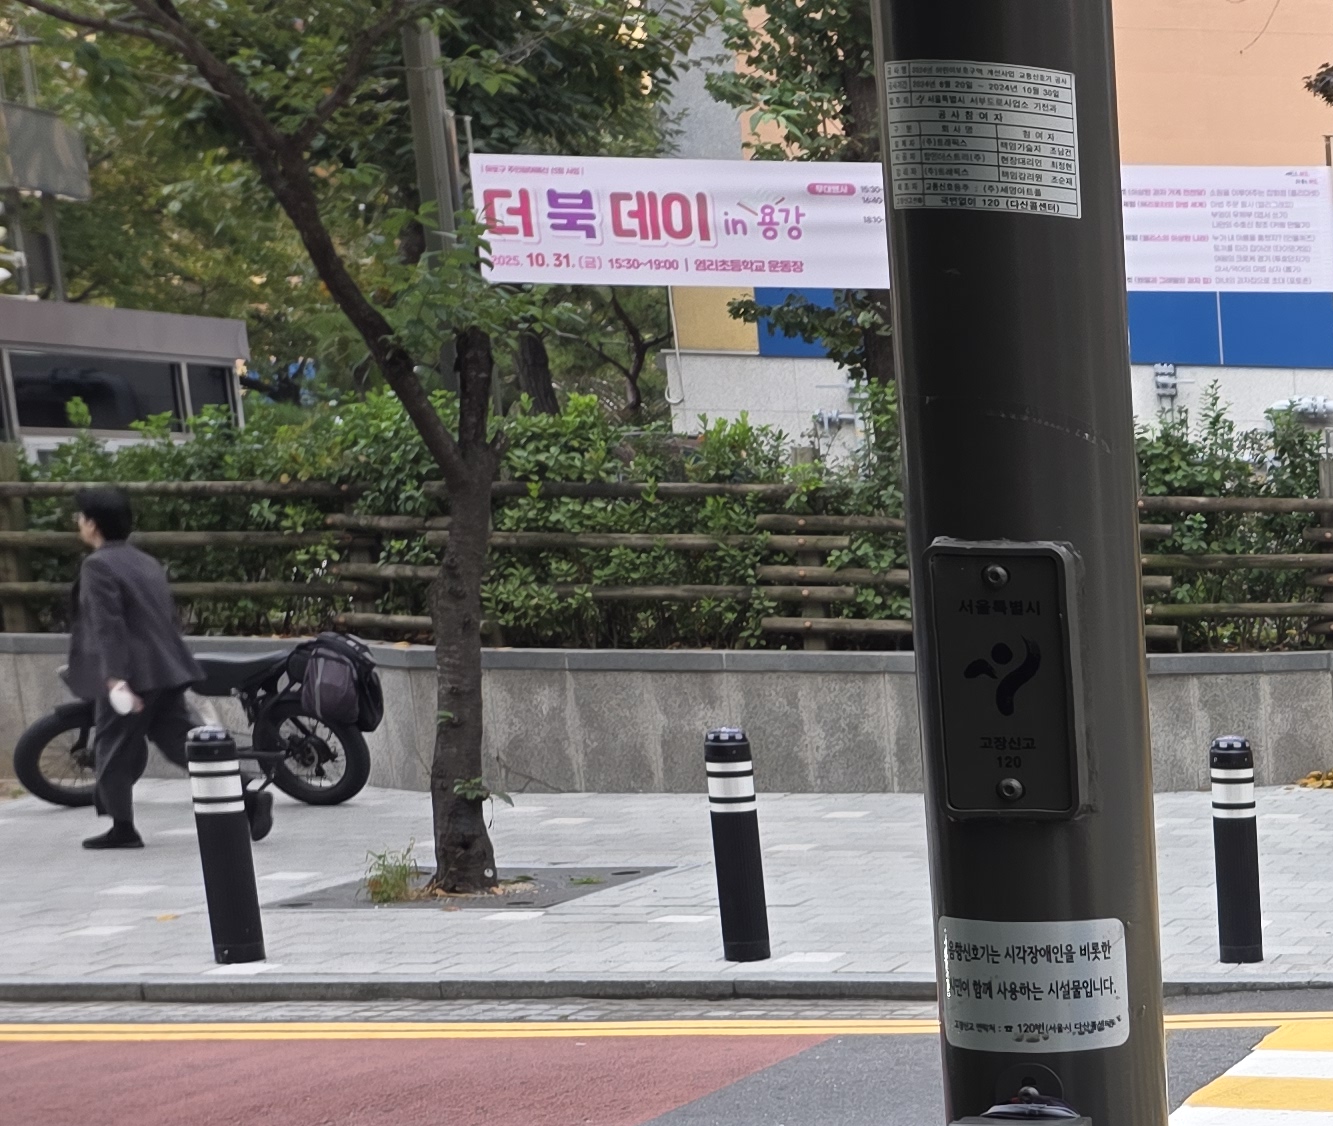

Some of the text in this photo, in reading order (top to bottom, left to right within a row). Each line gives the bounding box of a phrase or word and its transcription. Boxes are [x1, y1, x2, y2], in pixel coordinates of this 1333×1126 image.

[1055, 76, 1067, 85] 공사
[955, 81, 973, 90] 20일
[988, 83, 1018, 93] 2024년
[1022, 86, 1039, 95] 10월
[1043, 89, 1059, 98] 30일
[1001, 156, 1042, 167] 현장대리인
[982, 198, 1000, 207] 120
[1006, 199, 1060, 213] (다산콜센터)
[483, 188, 806, 241] 더 북 데이 in 용강
[608, 258, 679, 270] 15:30~19:00
[694, 259, 766, 272] 염리초등학교
[768, 261, 804, 273] 운동장
[958, 600, 1041, 616] 서울특별시
[980, 737, 1036, 750] 고장신고
[996, 756, 1022, 768] 120
[948, 940, 1112, 965] 음향신호기는 시각장애인을 비롯한
[972, 979, 993, 999] 함께
[997, 981, 1044, 1001] 사용하는
[1048, 976, 1117, 1000] 시설물입니다.
